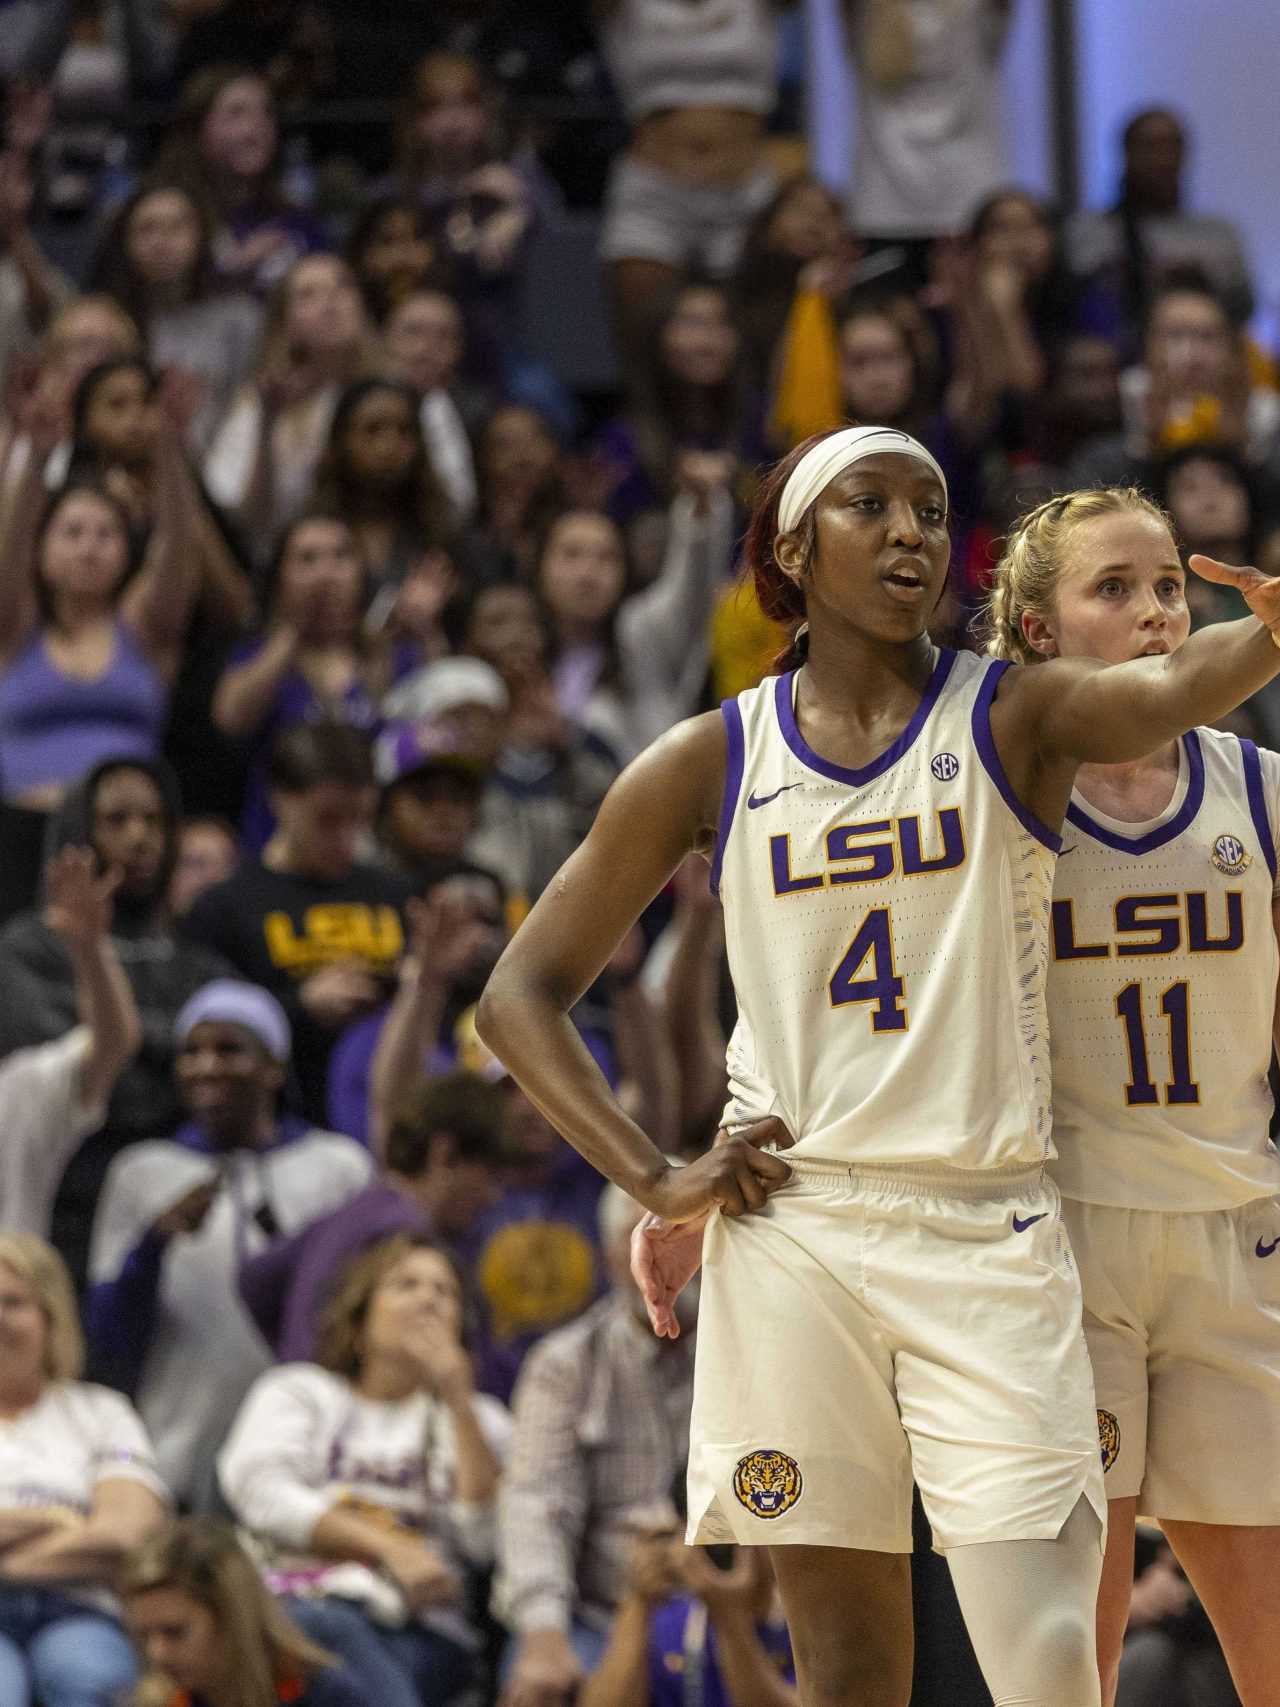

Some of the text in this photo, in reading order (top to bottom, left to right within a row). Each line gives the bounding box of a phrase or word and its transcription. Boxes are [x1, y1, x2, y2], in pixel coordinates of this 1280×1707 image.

[932, 754, 958, 780] SEC
[769, 806, 967, 898] LSU
[1216, 836, 1243, 865] SEC
[1051, 890, 1244, 961] LSU
[829, 905, 908, 1034] 4
[1115, 980, 1202, 1105] 11
